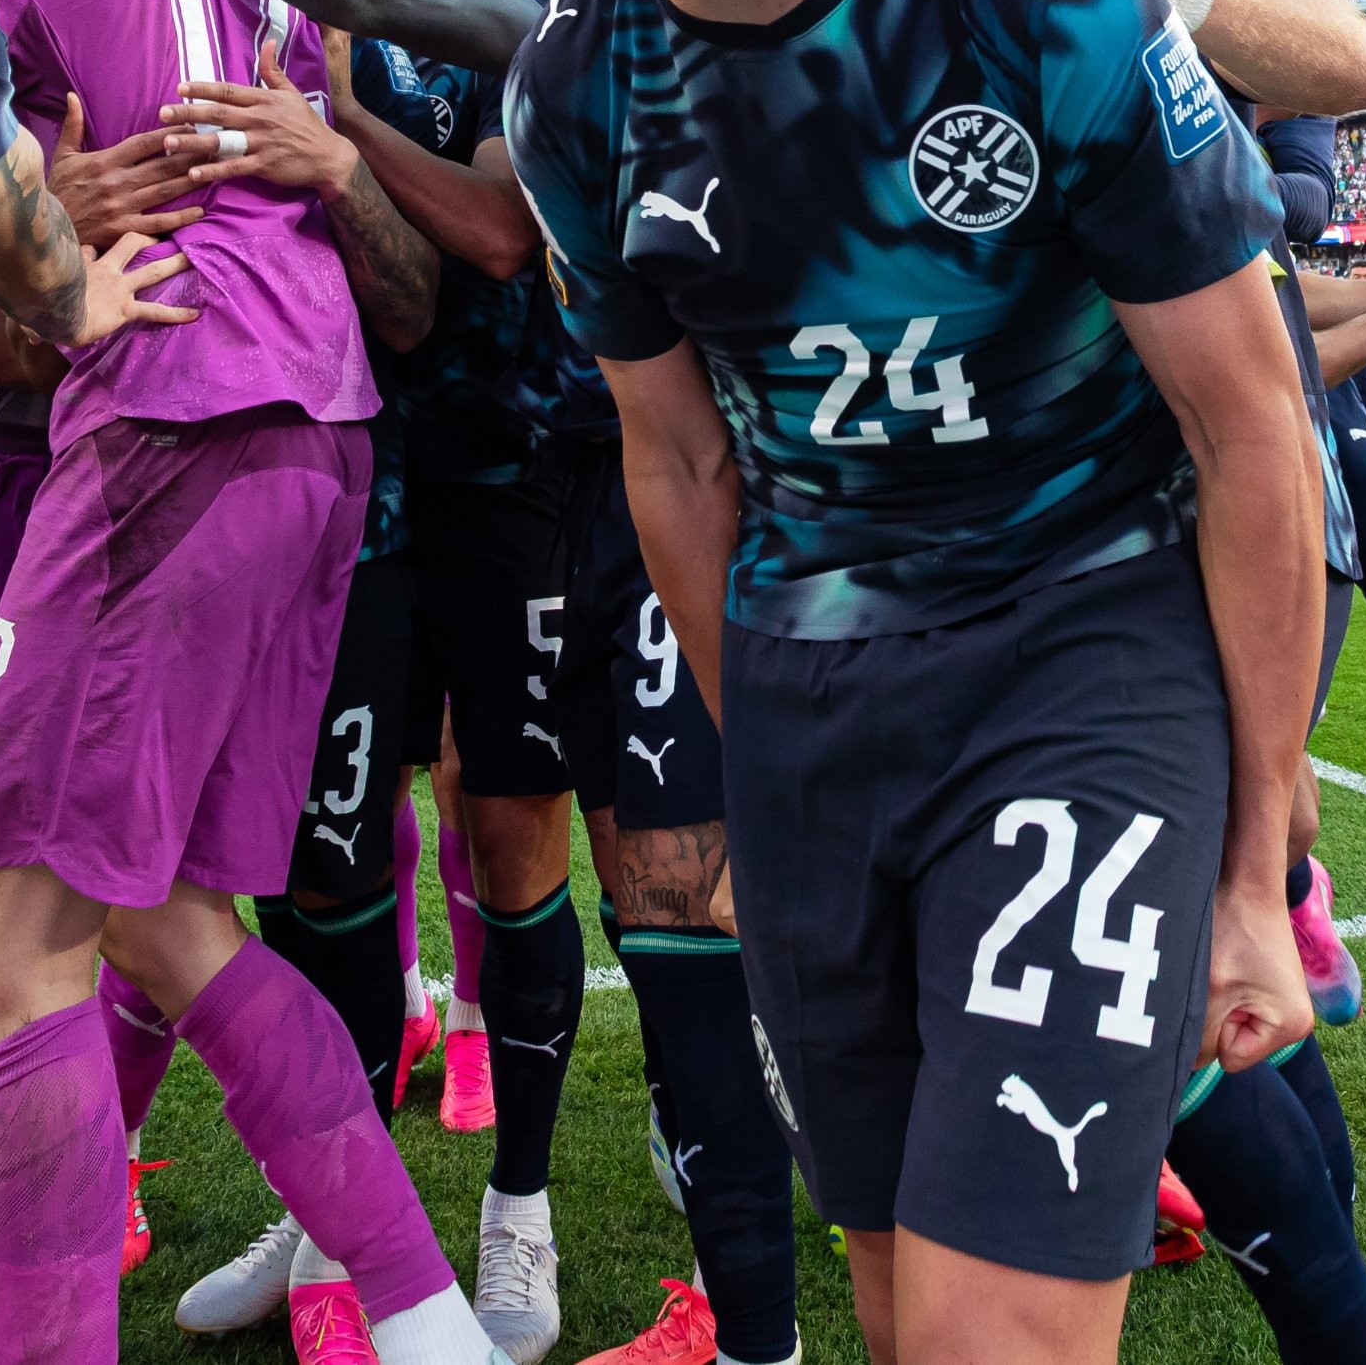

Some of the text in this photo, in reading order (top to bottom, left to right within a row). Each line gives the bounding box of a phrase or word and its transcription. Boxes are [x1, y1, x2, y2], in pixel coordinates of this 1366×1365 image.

[943, 115, 983, 141] APF
[1172, 100, 1195, 126] the
[954, 202, 1013, 225] PARAGUAY
[789, 315, 990, 446] 24
[635, 591, 679, 708] 9
[964, 797, 1166, 1048] 24
